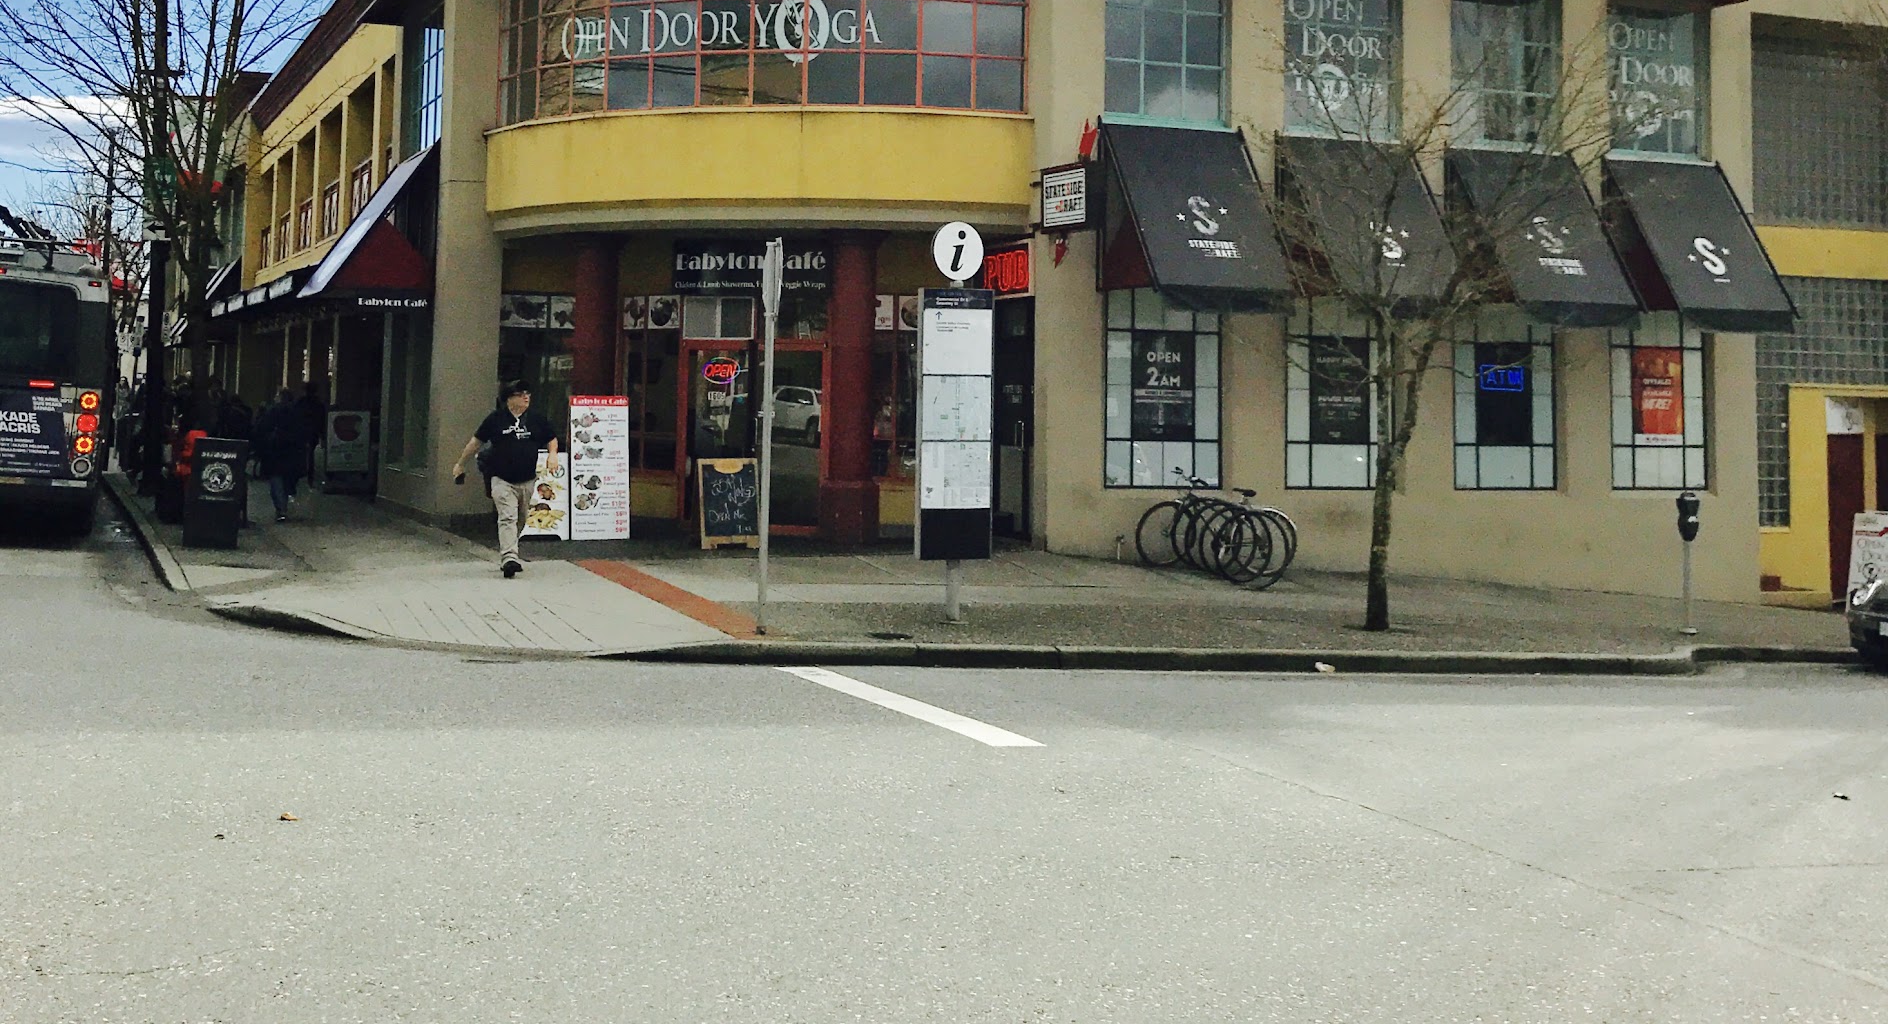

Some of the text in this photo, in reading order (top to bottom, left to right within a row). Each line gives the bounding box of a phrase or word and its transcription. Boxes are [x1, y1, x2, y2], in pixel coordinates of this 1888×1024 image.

[561, 15, 631, 61] OPEN
[640, 8, 743, 53] DOOR
[1302, 24, 1385, 60] DOOR
[1609, 22, 1674, 52] OPEN
[1621, 57, 1694, 87] DOOR
[1188, 196, 1219, 235] S
[676, 251, 827, 271] Babylon afé
[1694, 237, 1726, 275] S
[984, 250, 1029, 291] PUB
[358, 297, 428, 308] Babylon Café
[1146, 351, 1181, 363] OPEN
[704, 363, 738, 378] OPEN
[1146, 366, 1181, 387] 2AM
[573, 397, 628, 406] Babylon Café
[0, 410, 37, 423] KADE
[0, 422, 41, 434] ACRIS
